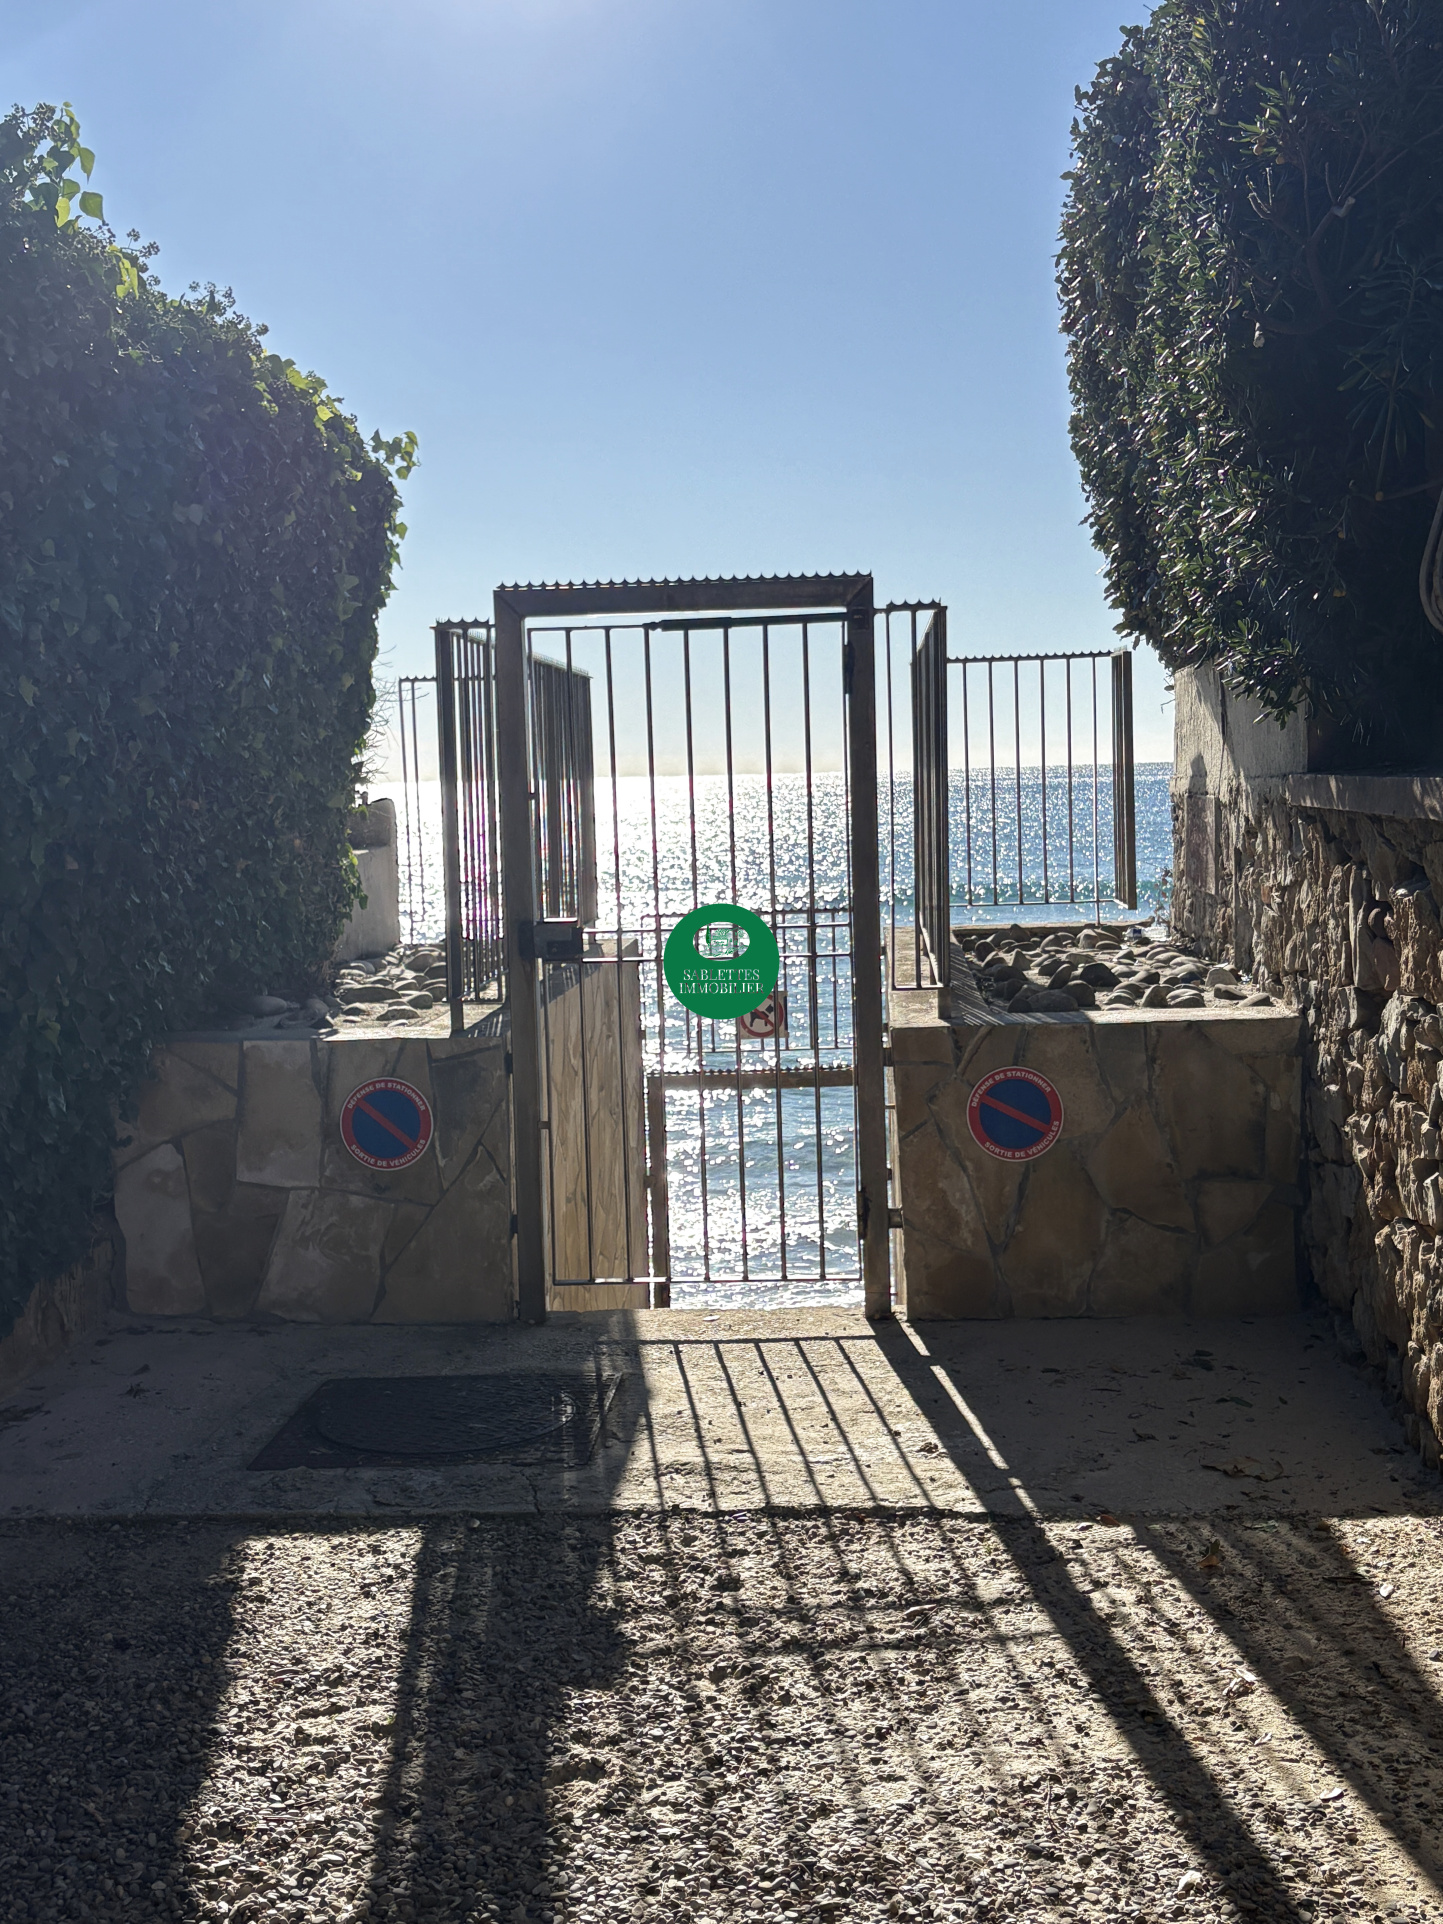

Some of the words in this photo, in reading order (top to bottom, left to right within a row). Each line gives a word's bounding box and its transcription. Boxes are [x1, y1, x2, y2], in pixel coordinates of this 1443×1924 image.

[995, 1073, 1004, 1081] DE
[1007, 1071, 1051, 1093] STATIONNER
[388, 1083, 425, 1111] STATIONNER
[351, 1145, 375, 1164] SORTIE
[985, 1142, 1012, 1157] SORTIE
